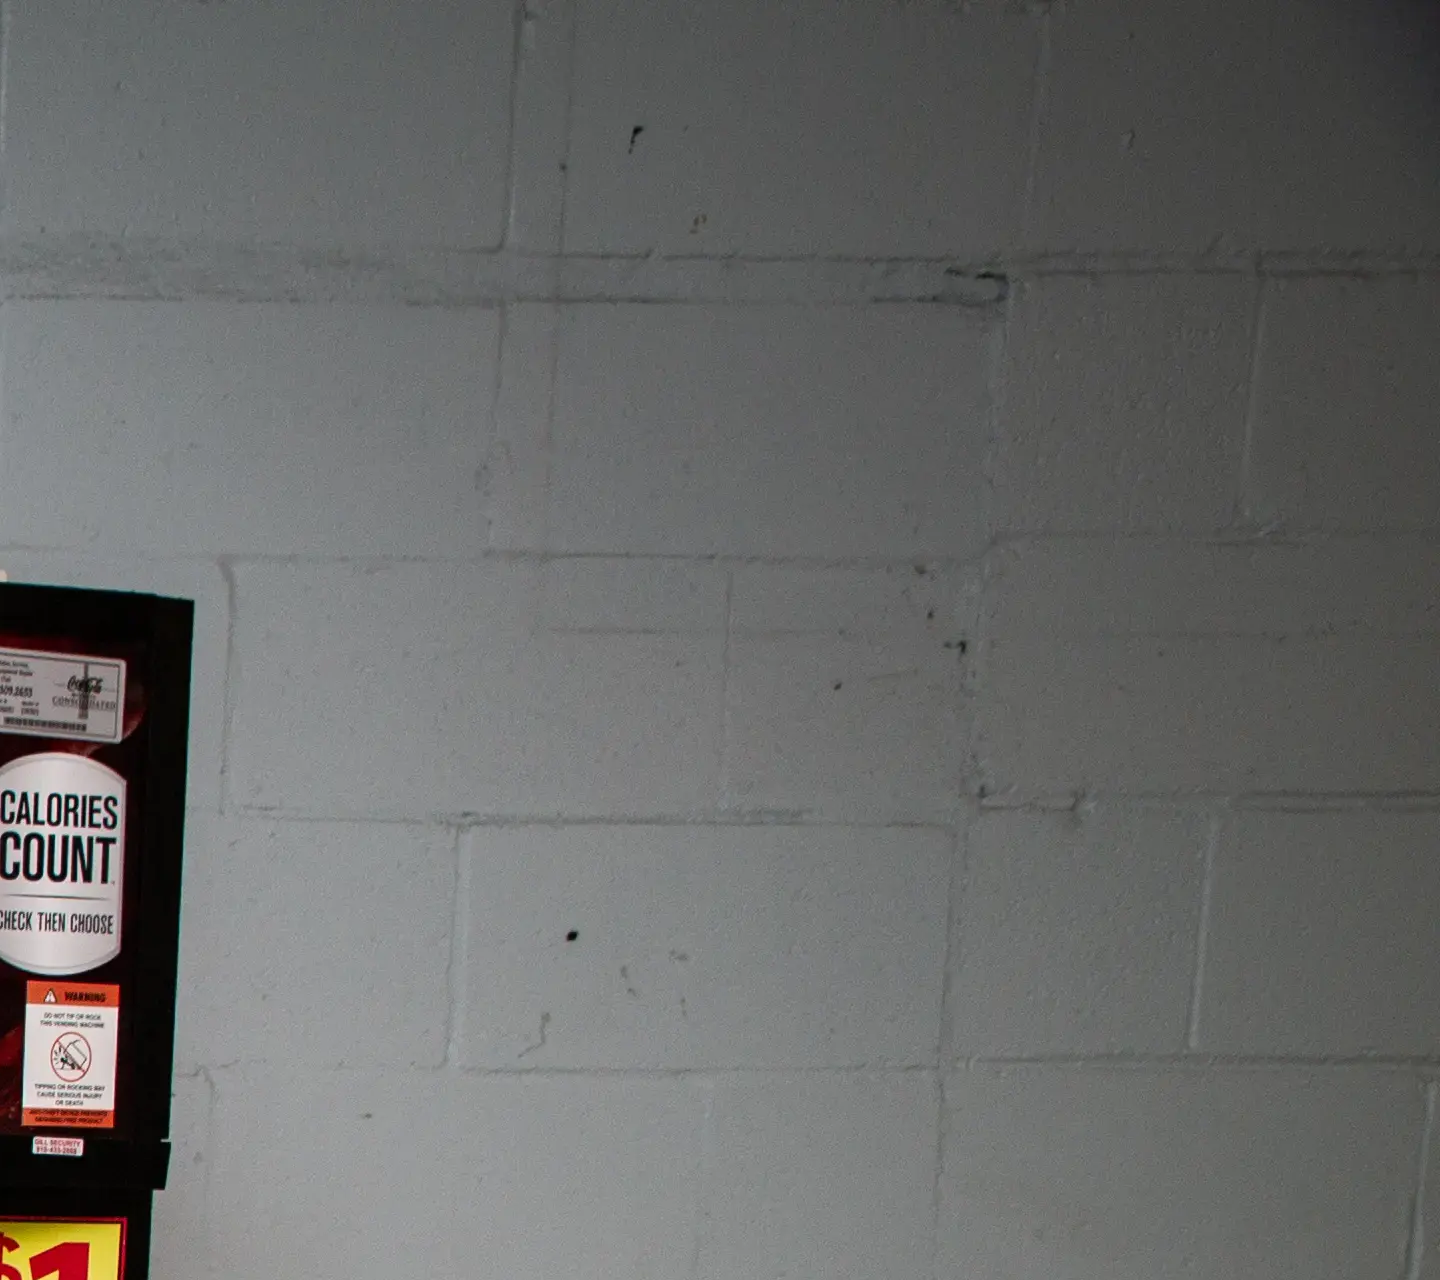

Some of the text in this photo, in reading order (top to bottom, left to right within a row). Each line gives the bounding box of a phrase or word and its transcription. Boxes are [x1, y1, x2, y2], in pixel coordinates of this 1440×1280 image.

[0, 789, 118, 831] CALORIES
[37, 911, 66, 933] THEN
[70, 912, 114, 935] CHOOSE
[64, 991, 106, 1004] WARNING
